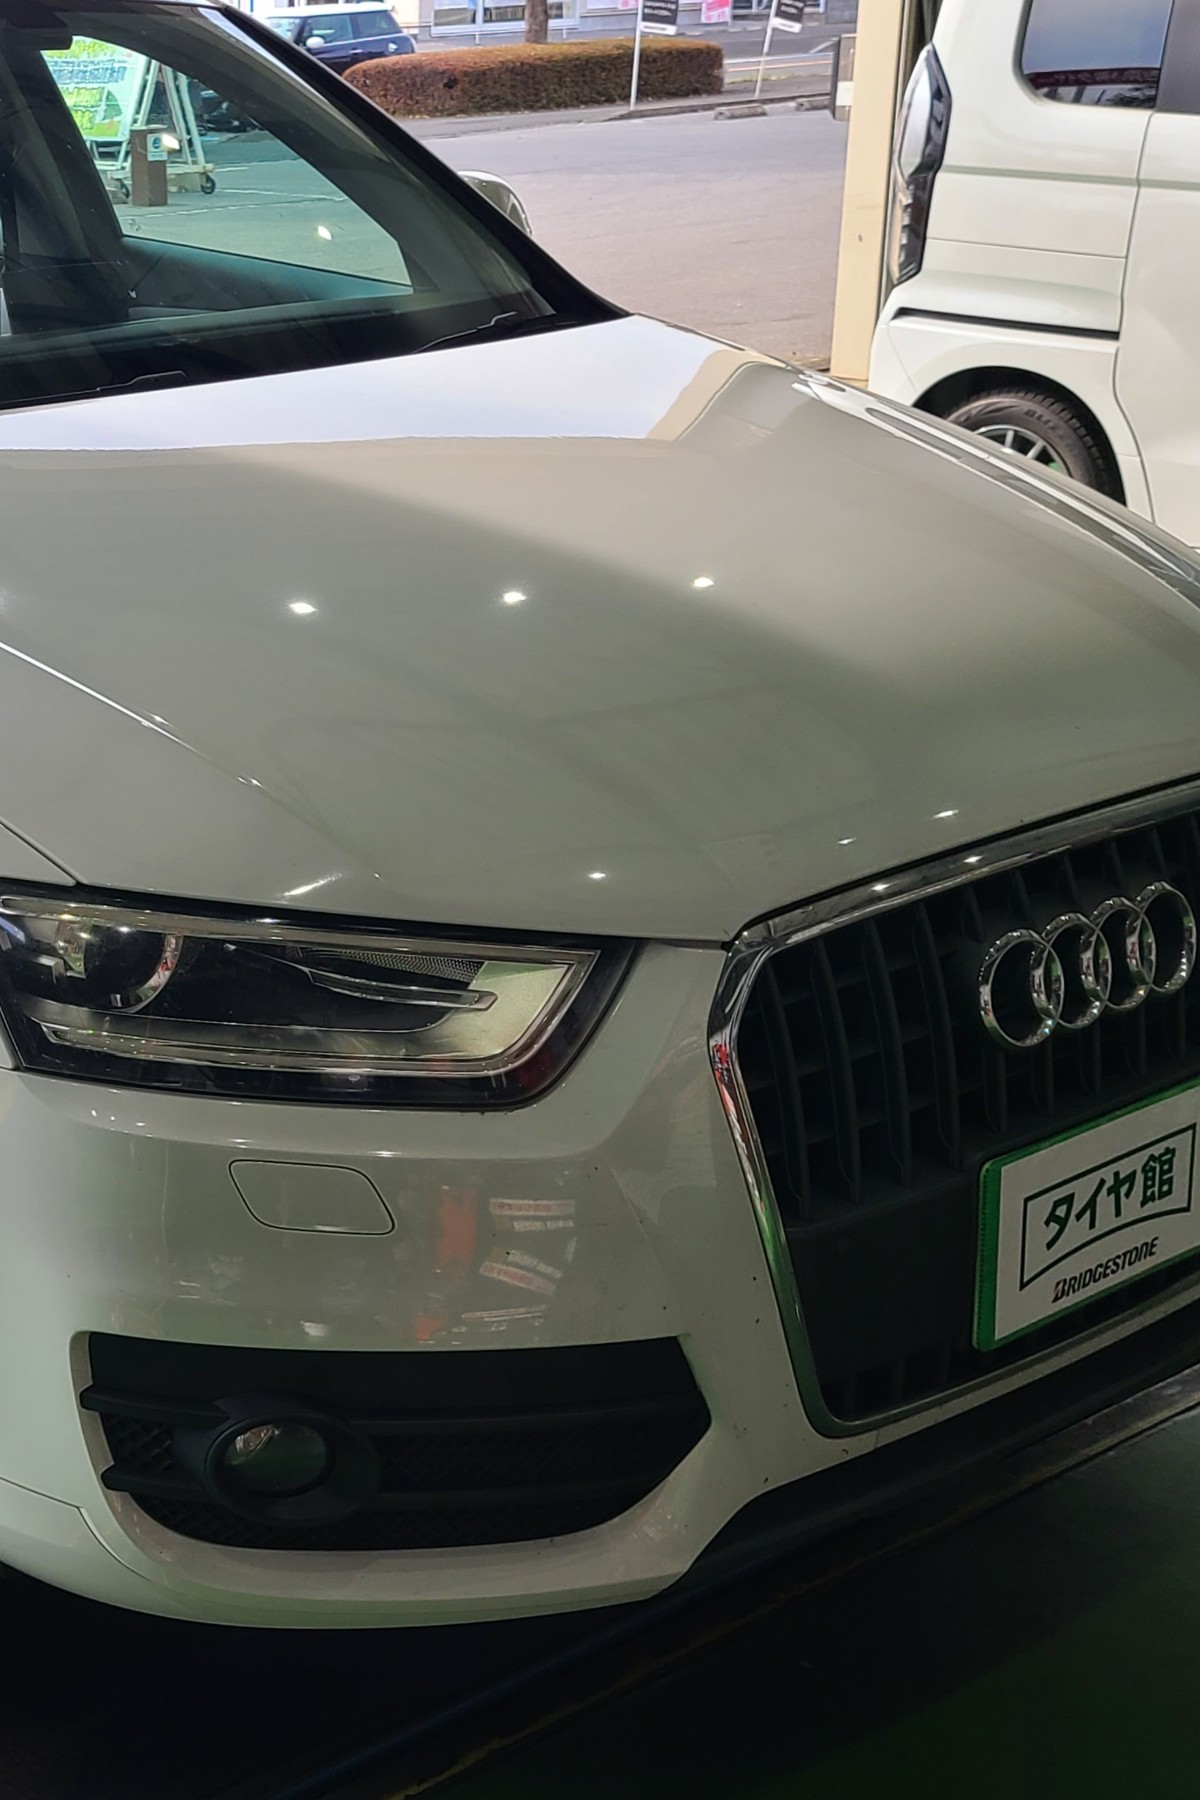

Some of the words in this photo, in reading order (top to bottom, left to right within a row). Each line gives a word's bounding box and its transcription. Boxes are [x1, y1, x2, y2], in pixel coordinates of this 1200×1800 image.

[1043, 1146, 1177, 1251] タイヤ館
[1051, 1236, 1160, 1304] BRIDGESTONE
